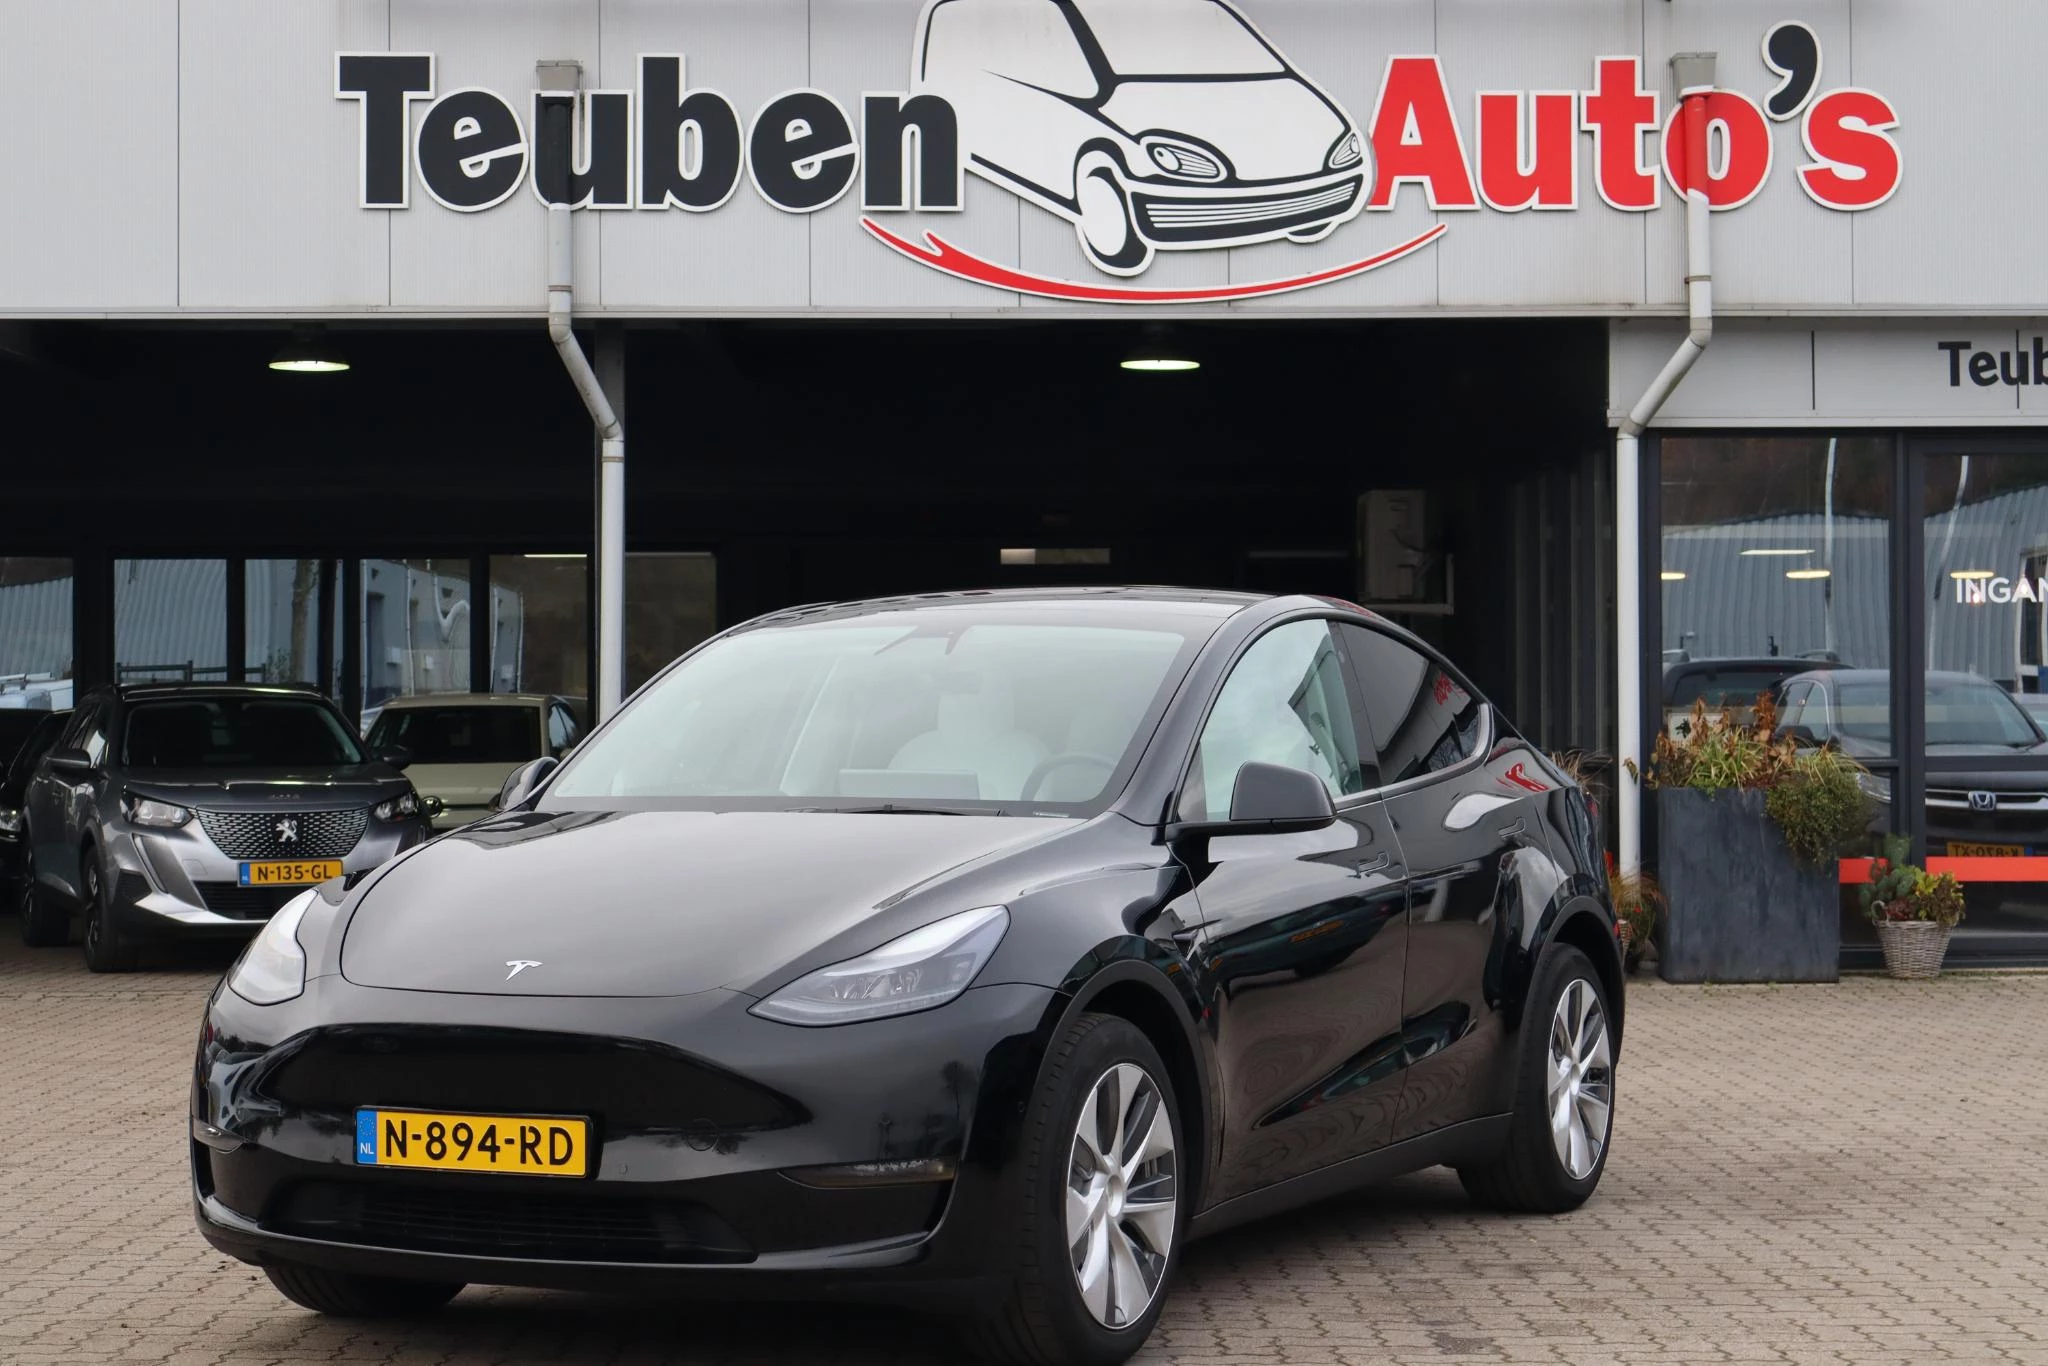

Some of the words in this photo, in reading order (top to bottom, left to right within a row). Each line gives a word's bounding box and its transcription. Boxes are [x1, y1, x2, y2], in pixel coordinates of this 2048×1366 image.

[336, 52, 963, 212] Teuben
[1367, 20, 1902, 212] Auto's
[257, 864, 333, 881] N-135-GL
[360, 1142, 374, 1155] NL
[385, 1119, 573, 1166] N-894-RD
